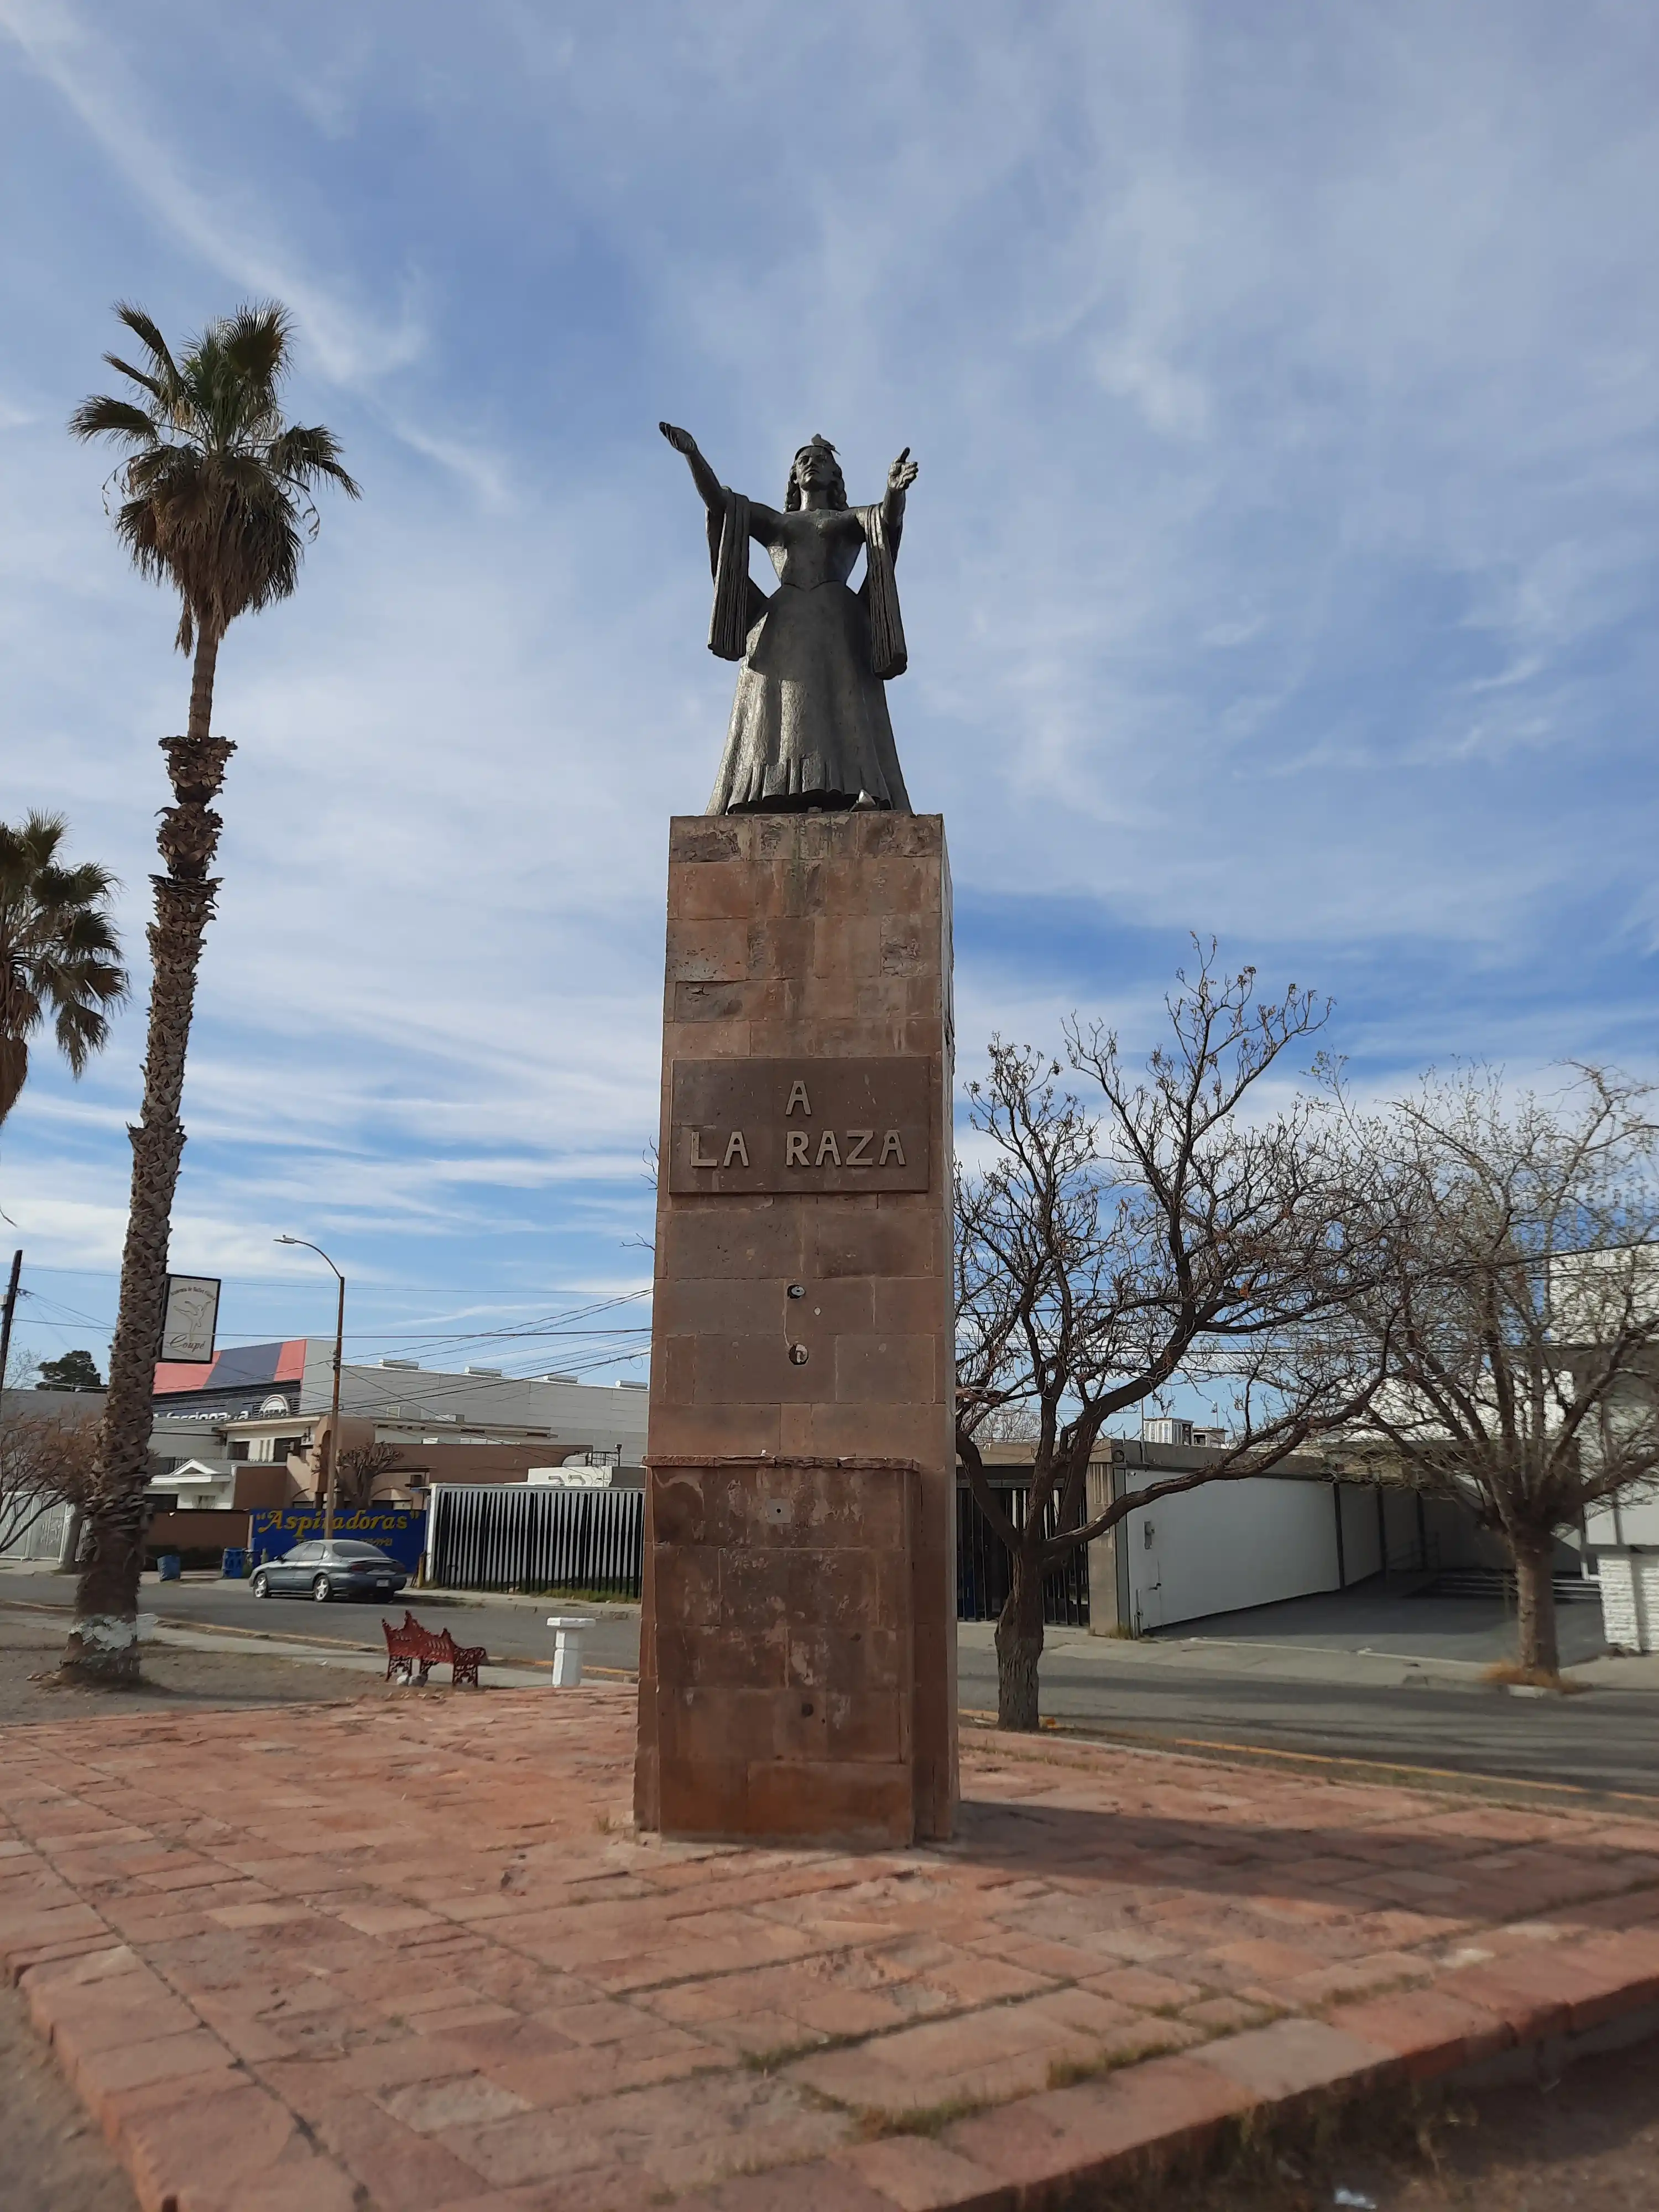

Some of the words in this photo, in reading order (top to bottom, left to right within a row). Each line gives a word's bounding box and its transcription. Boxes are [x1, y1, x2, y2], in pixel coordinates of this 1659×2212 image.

[785, 1080, 811, 1115] A
[690, 1131, 749, 1167] LA
[786, 1129, 906, 1166] RAZA
[256, 1509, 420, 1537] "Aspiadoras"
